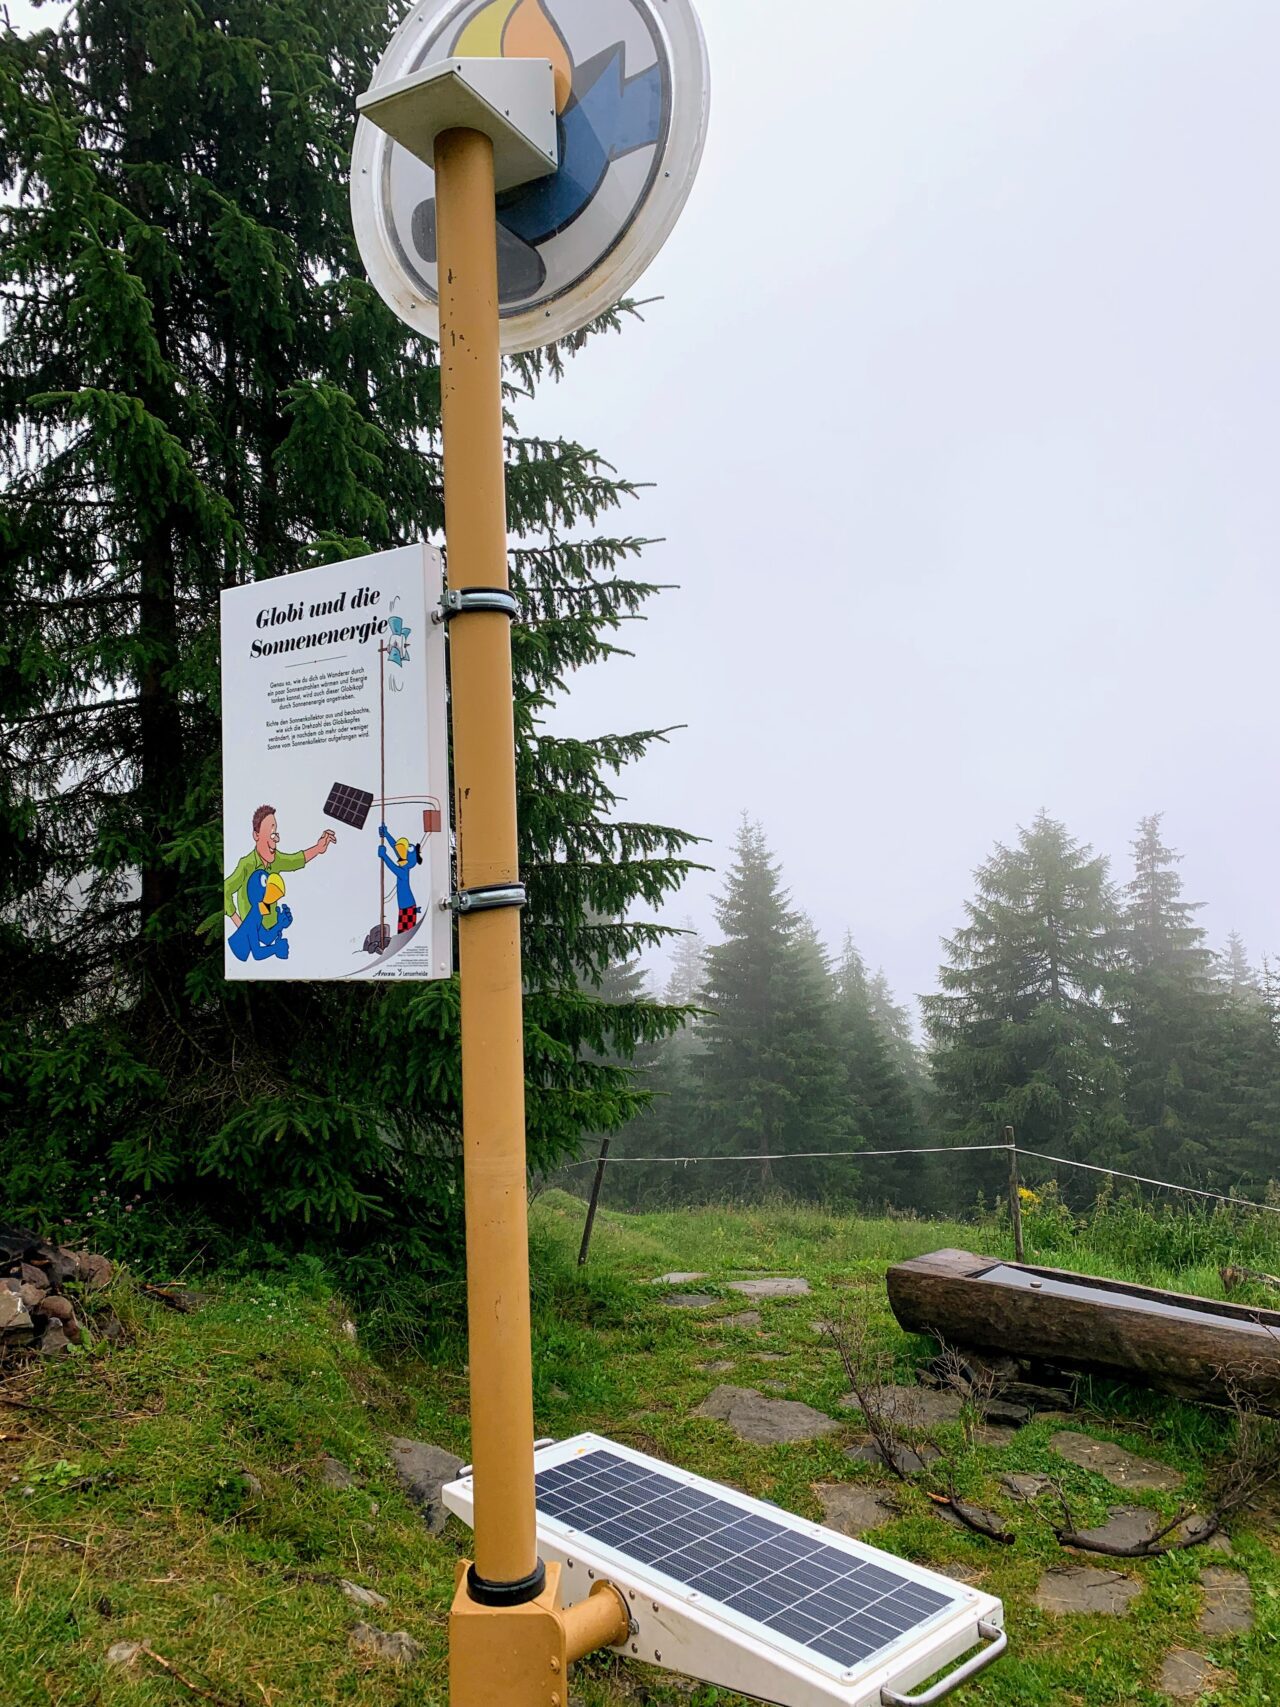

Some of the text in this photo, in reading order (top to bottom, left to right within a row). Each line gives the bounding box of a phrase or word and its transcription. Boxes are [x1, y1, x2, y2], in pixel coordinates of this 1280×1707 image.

[255, 586, 380, 629] Globi und die
[249, 615, 388, 659] Sonnenenergie
[270, 681, 284, 689] Genau
[302, 675, 308, 683] du
[308, 674, 318, 682] dich
[327, 669, 350, 679] Wanderer
[351, 666, 365, 675] durch
[275, 689, 285, 698] paar
[286, 682, 319, 694] Sonnenstrahlen
[321, 680, 339, 688] wärmen
[340, 677, 349, 685] und
[350, 674, 368, 685] Energie
[302, 690, 313, 698] wird
[313, 688, 325, 697] auch
[326, 687, 340, 695] dieser
[340, 681, 364, 693] Globikopf
[279, 693, 355, 710] durch Sonnenenergie angetrieben.
[266, 720, 279, 728] Richte
[280, 718, 288, 726] den
[289, 713, 325, 724] Sonnenkollektor
[334, 709, 343, 718] und
[344, 707, 370, 716] beobachte,
[284, 725, 293, 733] sich
[302, 720, 322, 730] Drehzahl
[323, 719, 331, 727] des
[332, 716, 360, 726] Globikopfes
[291, 733, 296, 741] je
[297, 729, 317, 738] nachdem
[317, 728, 324, 736] ob
[325, 726, 336, 735] mehr
[337, 725, 349, 733] oder
[350, 724, 369, 732] weniger
[267, 743, 281, 751] Sonne
[291, 736, 327, 747] Sonnenkollektor
[328, 733, 357, 743] aufgefangen
[372, 969, 396, 978] Arosa
